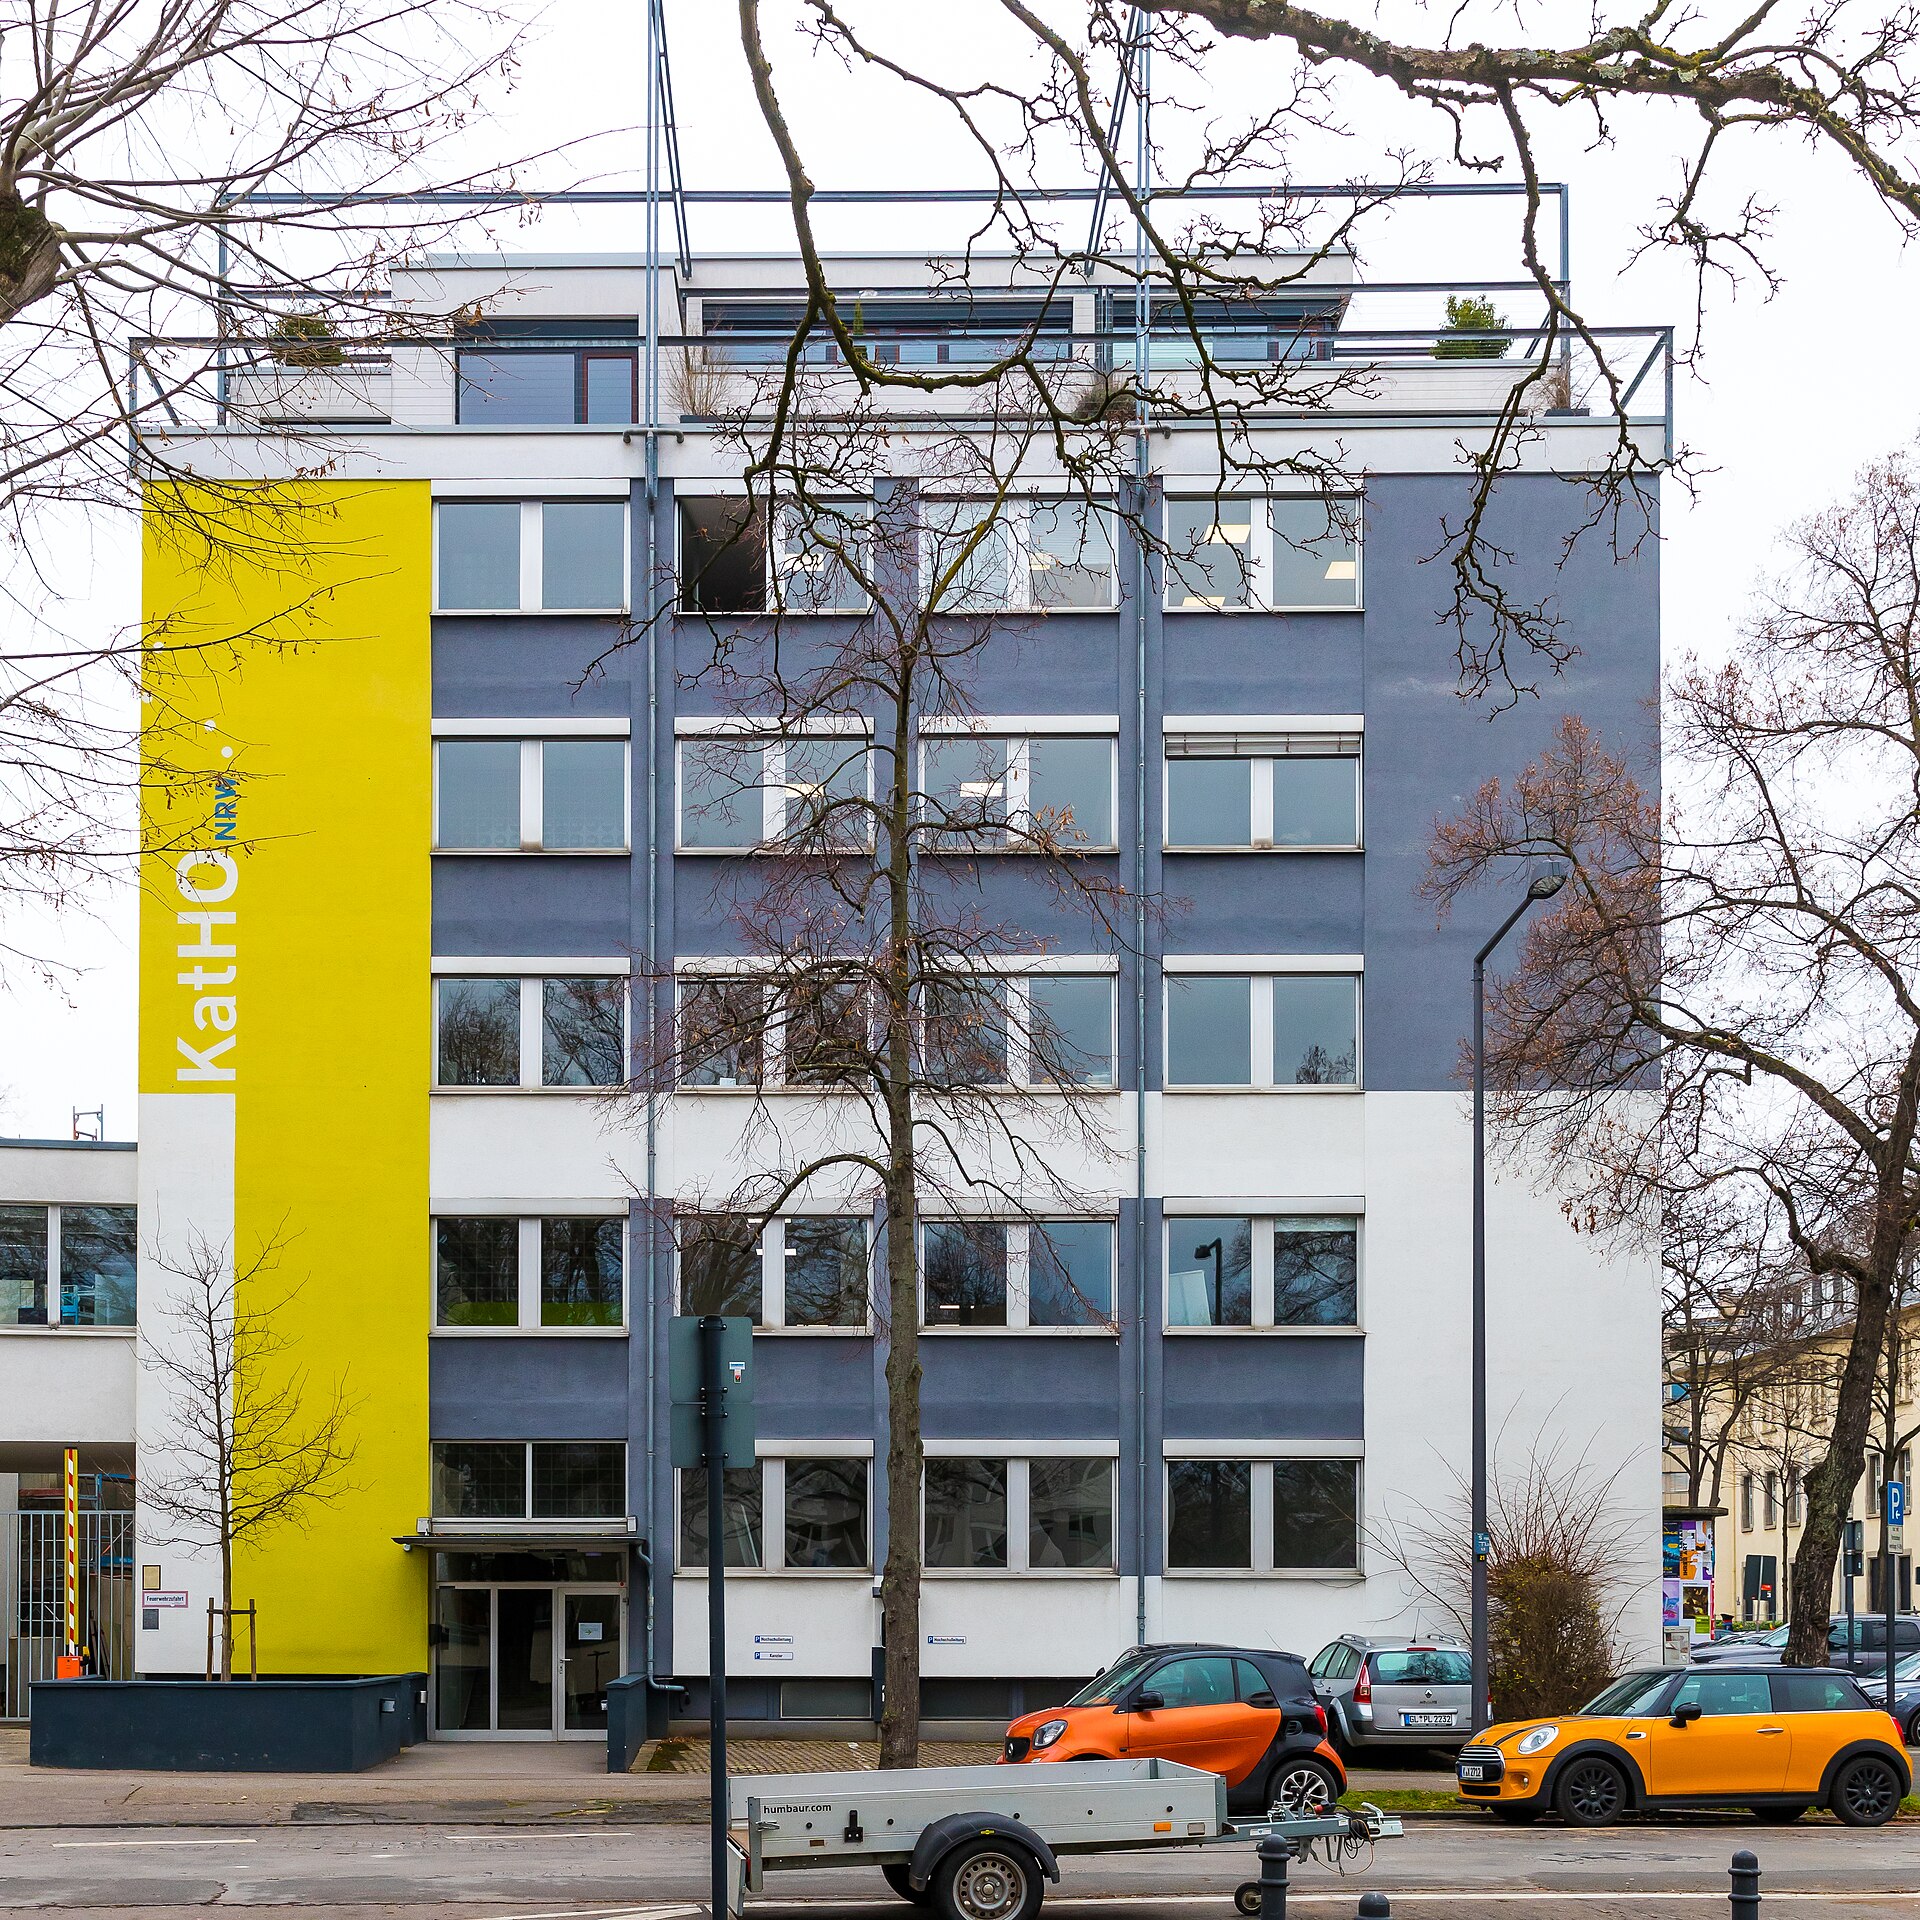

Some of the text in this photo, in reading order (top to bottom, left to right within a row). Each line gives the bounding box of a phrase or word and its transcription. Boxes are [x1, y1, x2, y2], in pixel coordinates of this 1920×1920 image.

[176, 777, 238, 1081] KatHO NRW
[1891, 1487, 1900, 1520] P
[763, 1804, 832, 1814] humbaur.com
